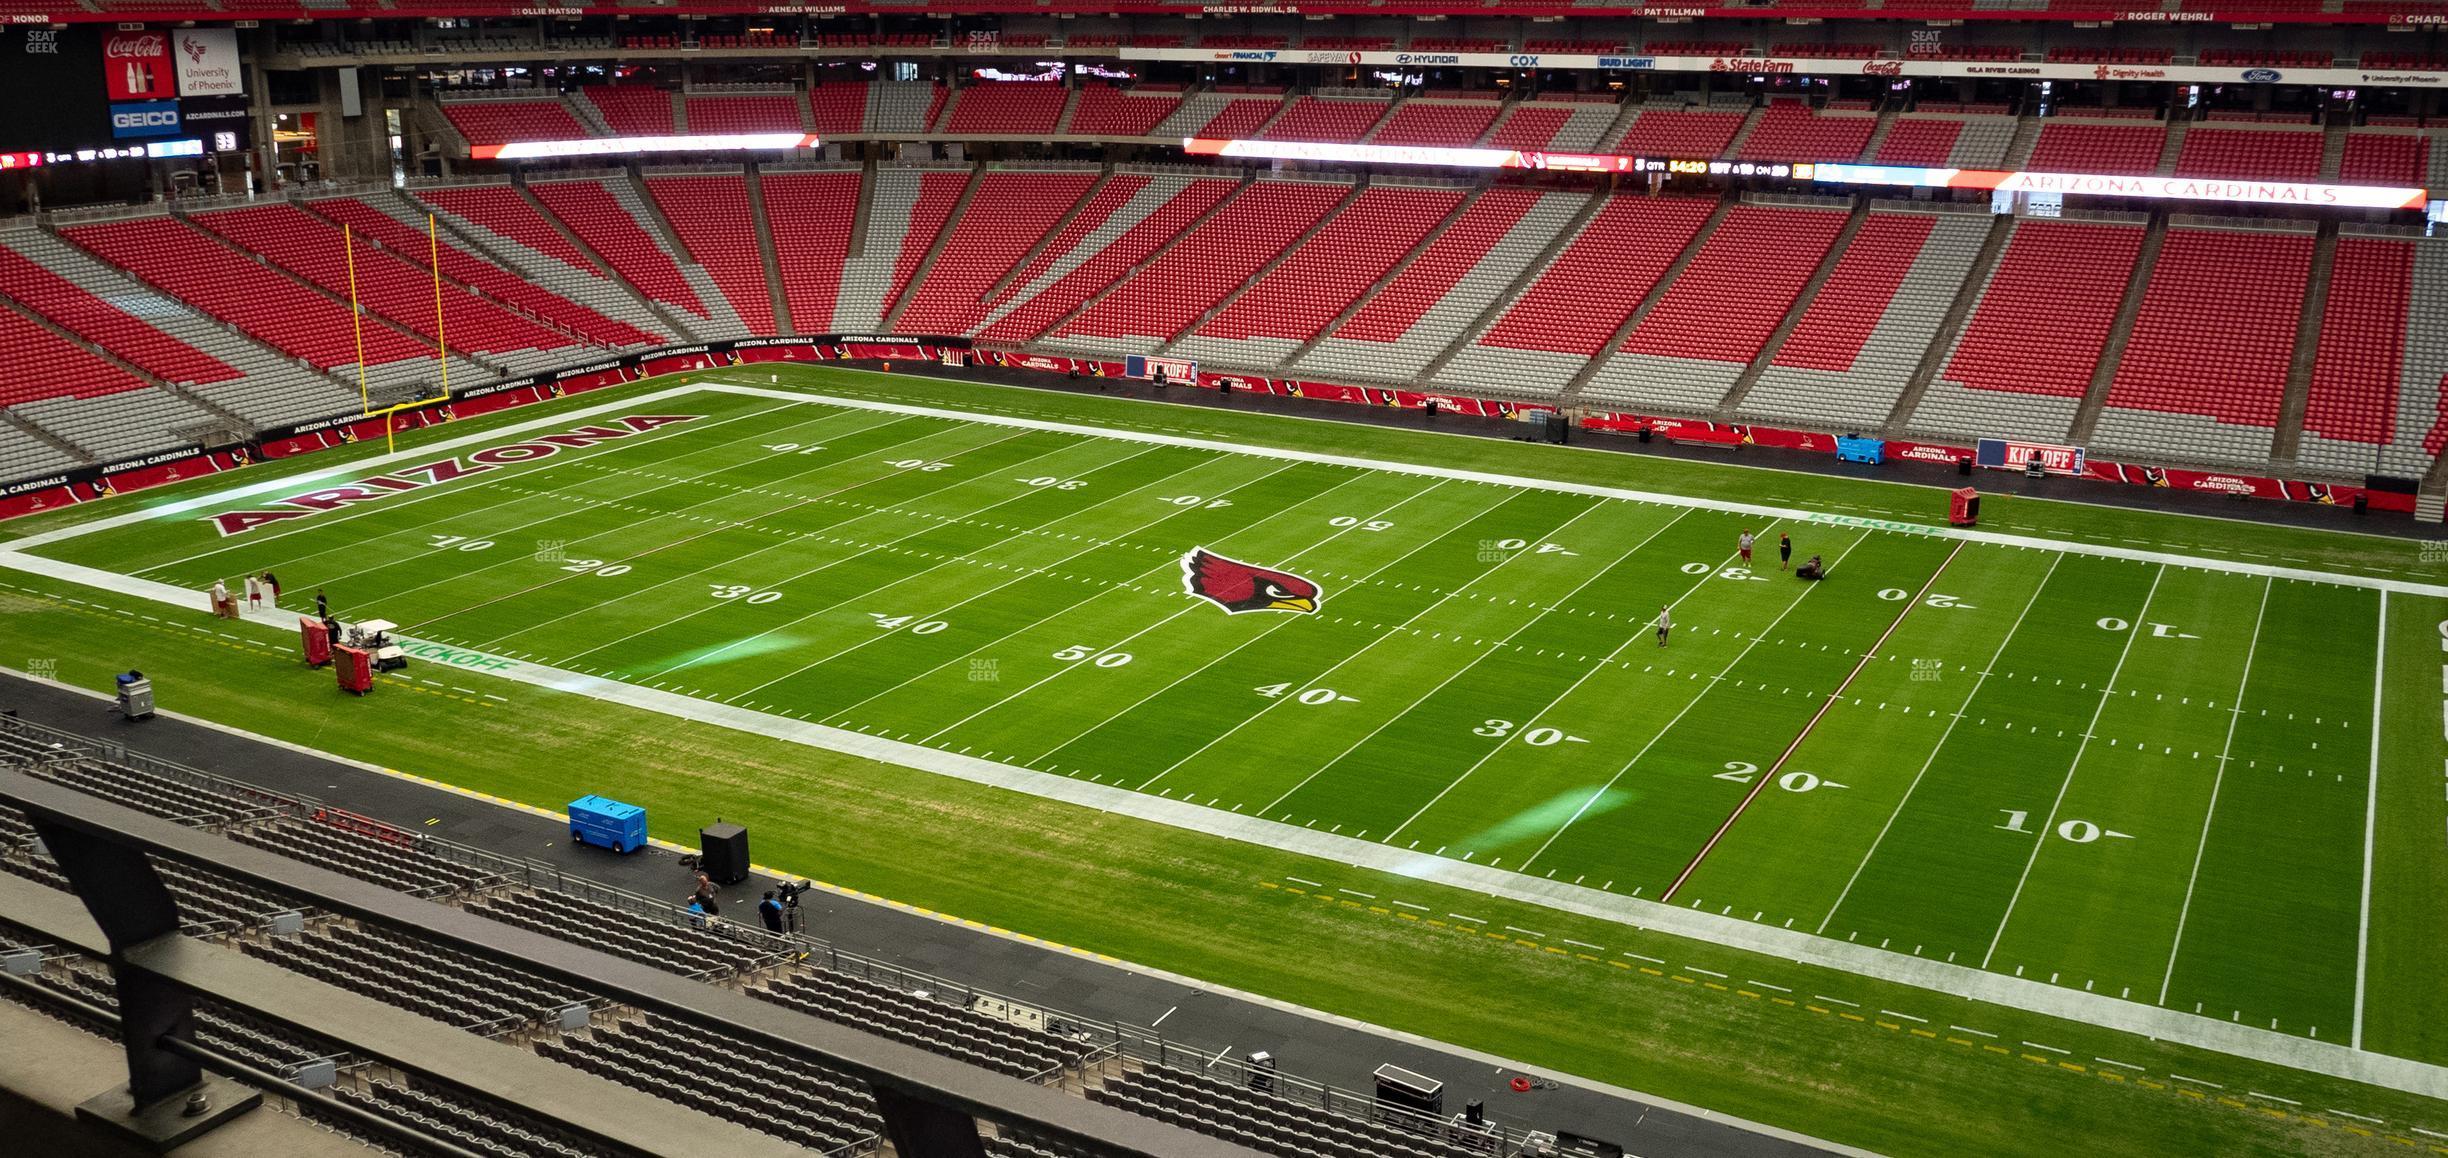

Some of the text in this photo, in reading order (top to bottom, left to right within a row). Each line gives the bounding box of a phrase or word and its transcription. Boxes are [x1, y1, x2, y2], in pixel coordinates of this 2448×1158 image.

[1251, 6, 1285, 14] BIDWILL,
[1287, 6, 1299, 14] SR.
[1664, 8, 1704, 16] TILLMAN
[2128, 12, 2166, 20] ROGER
[2168, 12, 2214, 20] WEHRLI
[13, 15, 49, 23] HONOR
[2389, 15, 2403, 23] 62
[107, 36, 162, 58] Coca-Cola
[1307, 52, 1349, 62] SAFEWAY
[1414, 56, 1458, 64] HYUNDAI
[1510, 56, 1538, 66] COX
[1600, 58, 1653, 68] BUD LIGHT
[186, 67, 230, 81] University
[1863, 61, 1904, 75] Coca-Cola
[2113, 69, 2165, 78] Dignity Health
[2249, 70, 2272, 81] Ford
[188, 79, 234, 91] of Phoenix
[114, 112, 177, 128] GEICO
[186, 110, 245, 120] AZCARDINALS.COM
[1618, 158, 1628, 170] 7
[1647, 162, 1665, 170] QTR
[1756, 166, 1771, 174] ON
[2020, 174, 2337, 202] ARIZONA CARDINALS
[734, 337, 814, 348] ARIZONA CARDINALS
[872, 336, 919, 344] CARDINALS
[640, 346, 708, 361] ARIZONA CARDINALS
[556, 360, 620, 378] ARIZONA CARDINALS
[1022, 360, 1058, 369] CARDINALS
[1146, 361, 1188, 378] KIKOFF
[464, 378, 534, 398] ARIZONA CARDINALS
[1212, 380, 1252, 389] CAINALS
[1417, 401, 1462, 410] CAINALS
[294, 421, 332, 434] ARIZONA
[1652, 420, 1682, 428] ARIZONA
[1902, 450, 1956, 462] CARDINALS
[1913, 446, 1946, 454] ARIZONA
[102, 448, 200, 474] ARIZONA CARDINALS
[2008, 446, 2070, 468] KICOFF
[198, 414, 709, 537] ARIZONA
[2207, 476, 2244, 484] ARIZONA
[10, 476, 68, 493] CARDINALS
[1809, 511, 1946, 535] KICKOFF
[400, 638, 519, 672] KICKOFF
[1052, 645, 1133, 668] 50
[1253, 682, 1336, 705] 40
[1472, 720, 1563, 746] 30
[1713, 761, 1819, 792] 20
[1994, 809, 2100, 843] 10
